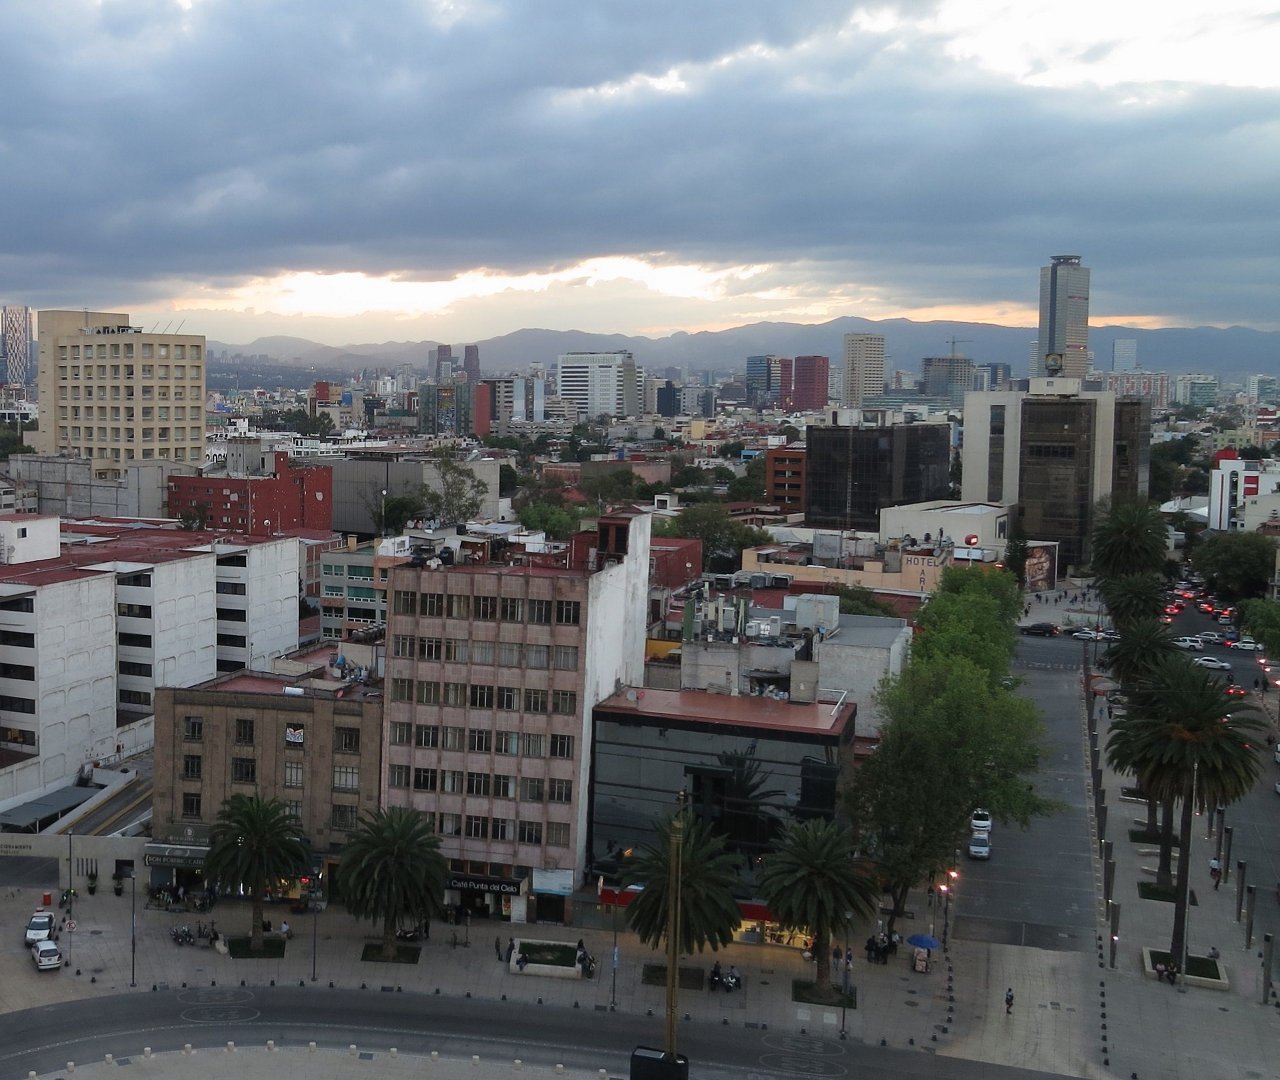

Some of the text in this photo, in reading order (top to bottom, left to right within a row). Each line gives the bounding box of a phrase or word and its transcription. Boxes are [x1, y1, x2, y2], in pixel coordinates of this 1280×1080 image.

[906, 557, 939, 567] HOTEL
[451, 880, 517, 893] Café Punta del Cielo
